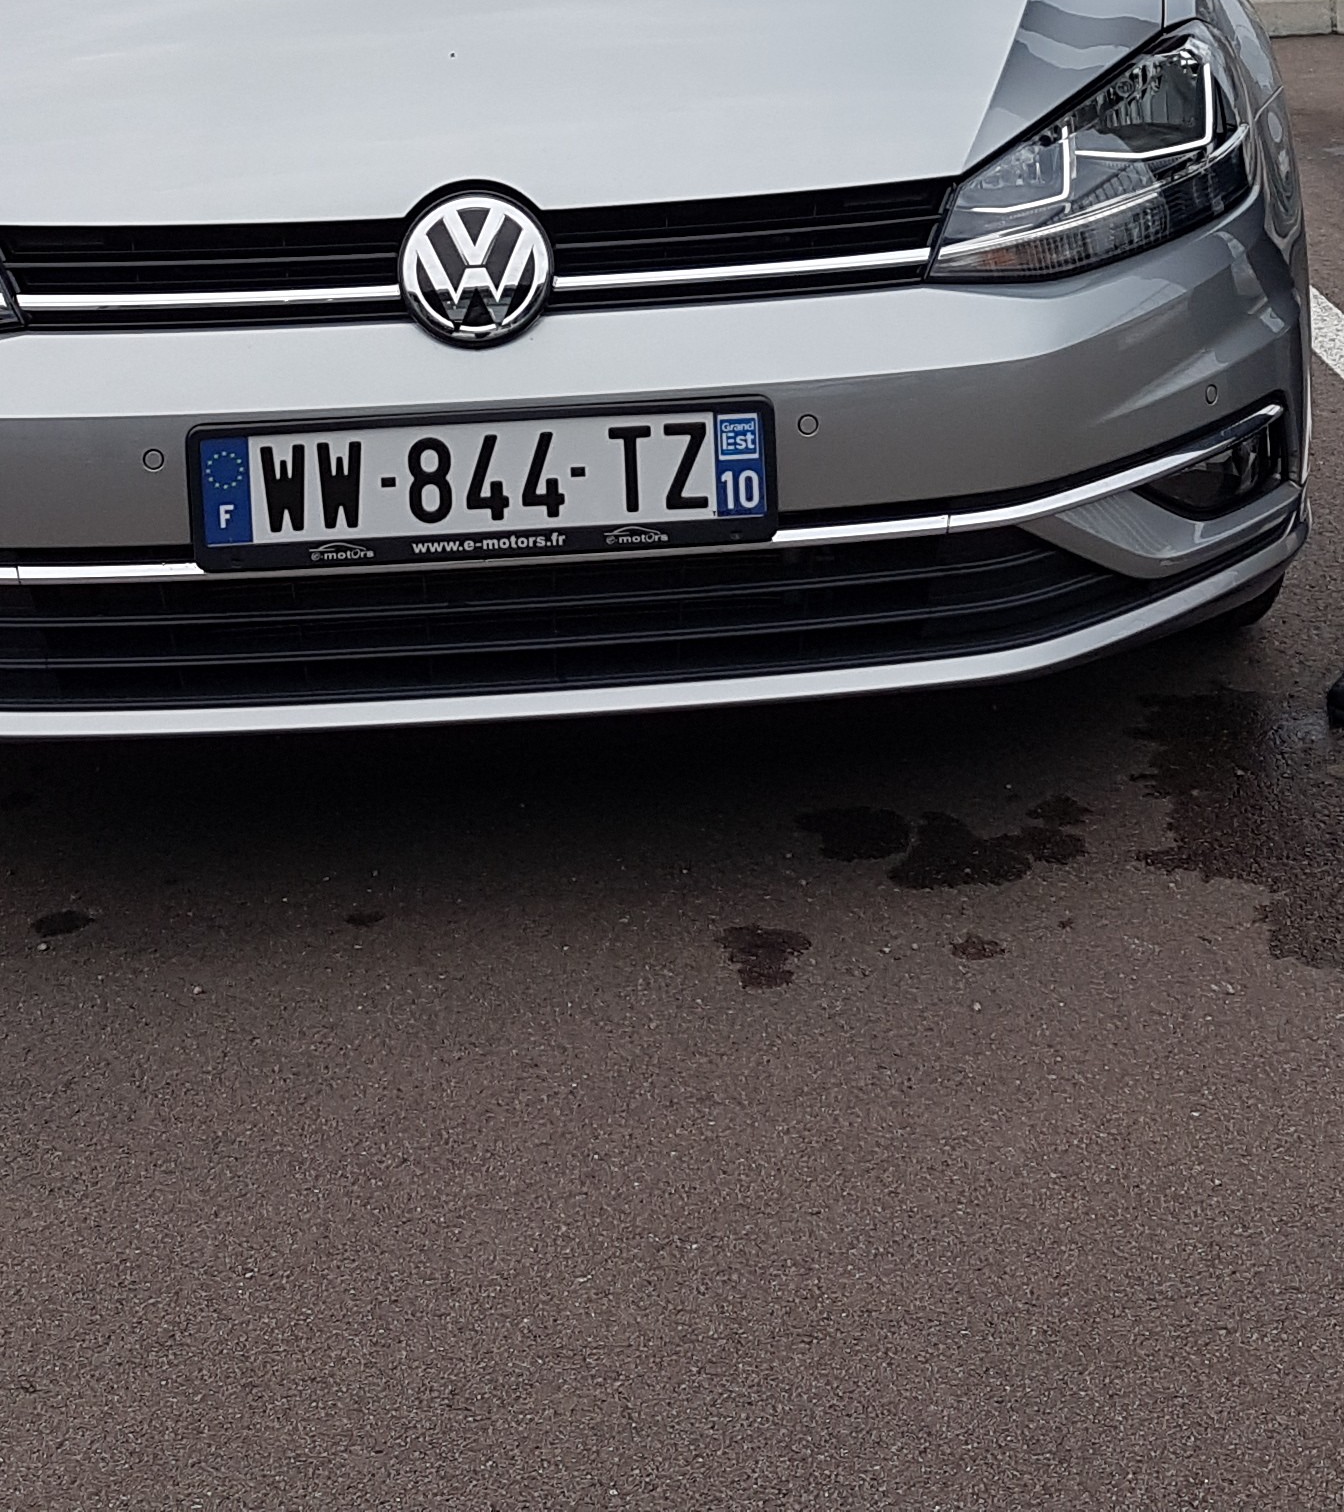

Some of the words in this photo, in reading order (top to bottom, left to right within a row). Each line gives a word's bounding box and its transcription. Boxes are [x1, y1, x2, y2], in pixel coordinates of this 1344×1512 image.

[721, 421, 755, 432] Grand
[721, 432, 755, 450] Est
[259, 421, 709, 533] WW-844-TZ
[721, 469, 760, 510] 10
[218, 503, 235, 529] F
[412, 533, 566, 554] www.e-motors.fr
